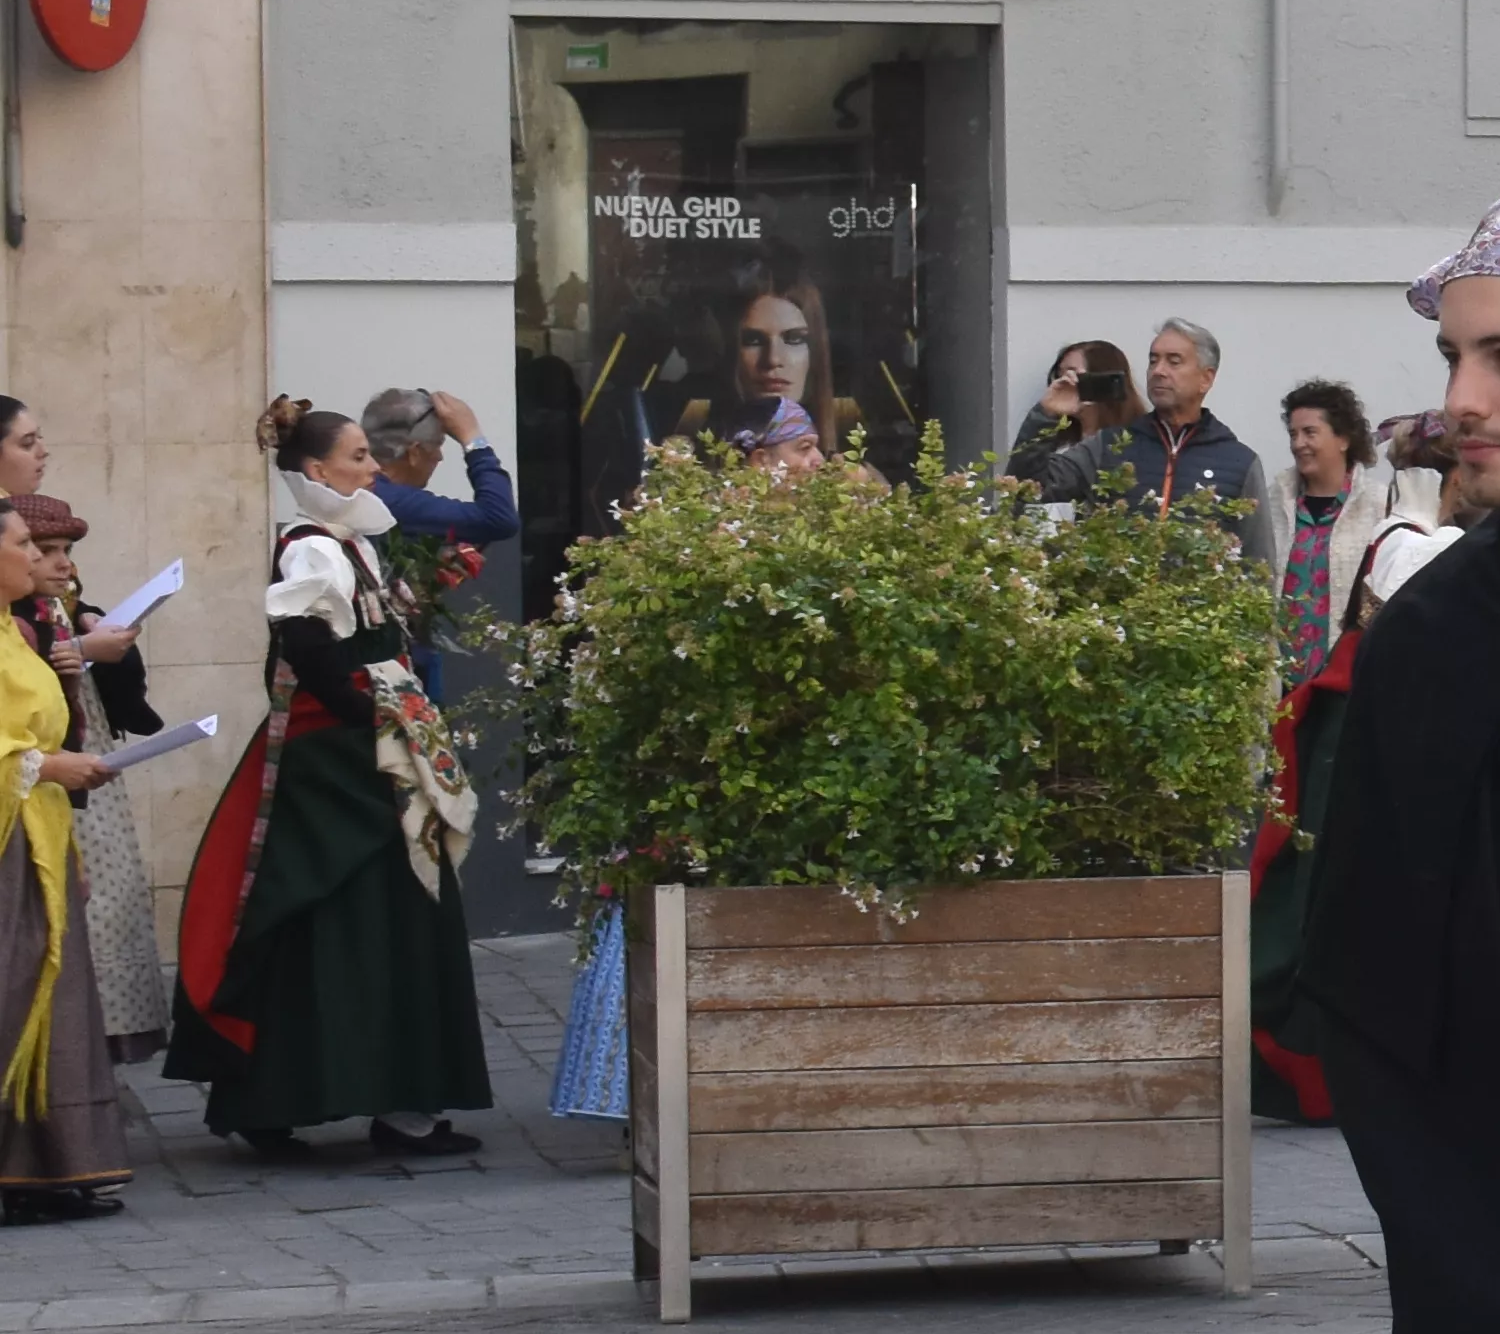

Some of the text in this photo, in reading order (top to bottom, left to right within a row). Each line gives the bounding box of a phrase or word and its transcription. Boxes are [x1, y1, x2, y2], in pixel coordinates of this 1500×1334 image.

[594, 196, 742, 218] NUEVA GHD
[828, 197, 896, 238] ghd
[629, 217, 762, 239] DUET STYLE
